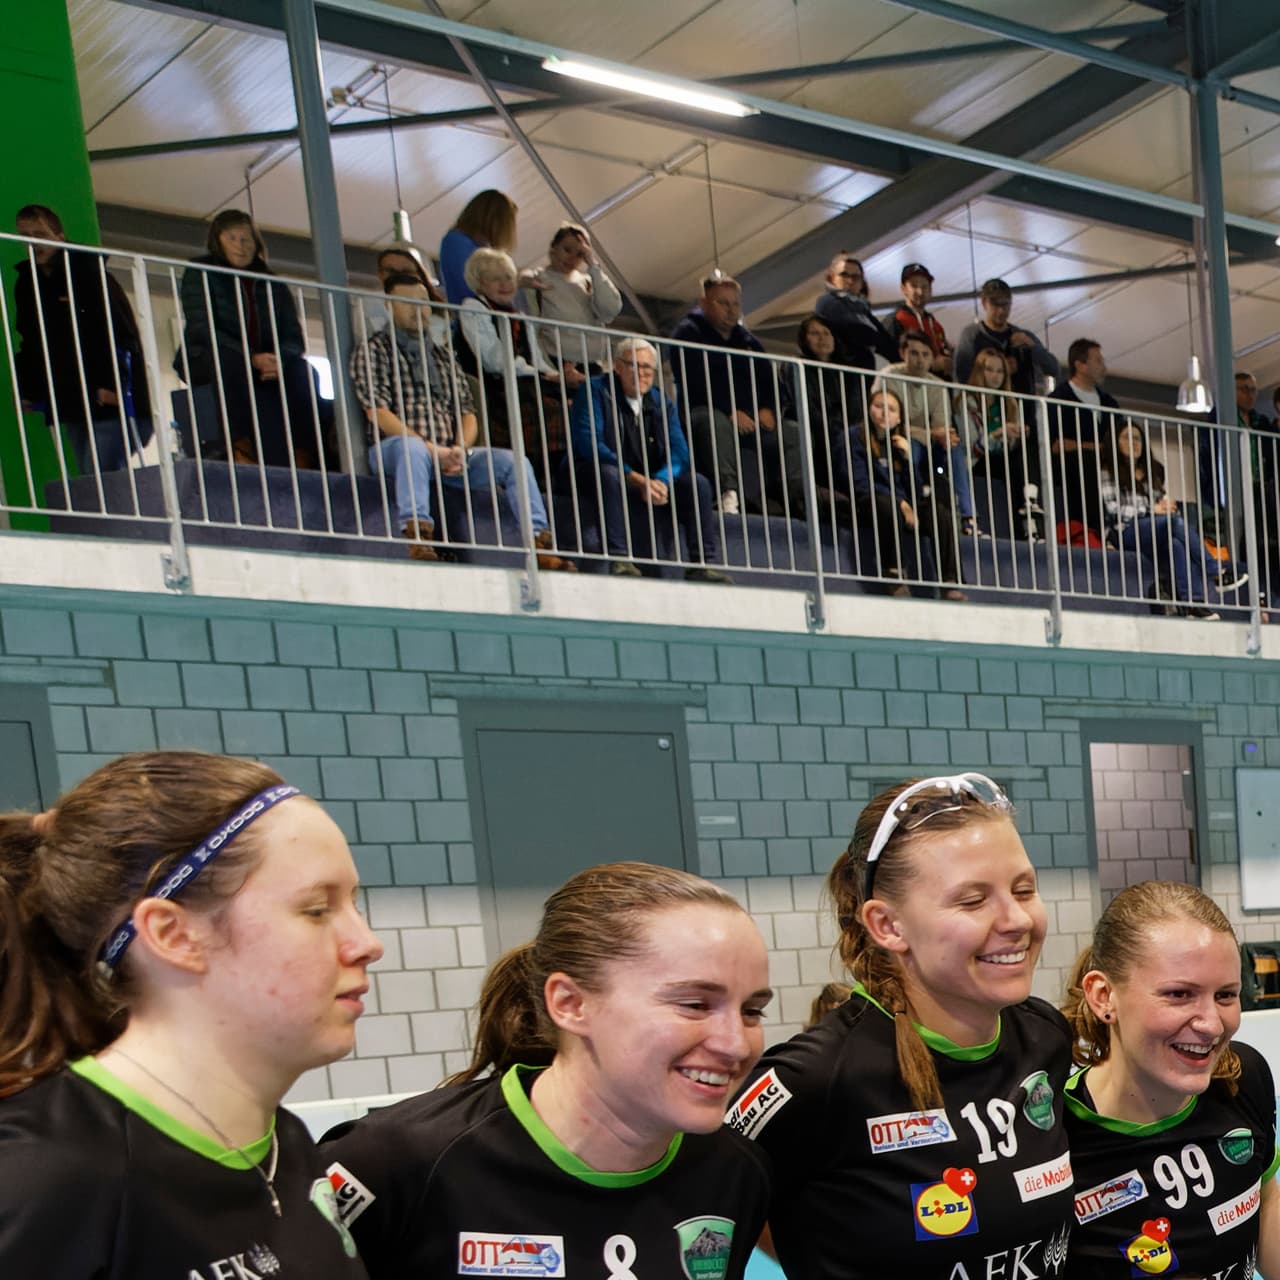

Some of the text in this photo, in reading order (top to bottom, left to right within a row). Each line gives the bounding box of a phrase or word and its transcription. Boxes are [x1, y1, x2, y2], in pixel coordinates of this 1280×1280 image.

[757, 1083, 779, 1107] AG
[871, 1120, 905, 1145] OTT
[960, 1097, 1018, 1164] 19
[1024, 1174, 1043, 1194] die
[1153, 1143, 1215, 1209] 99
[1074, 1191, 1102, 1216] OTT
[1217, 1209, 1236, 1227] die
[461, 1240, 501, 1266] OTT
